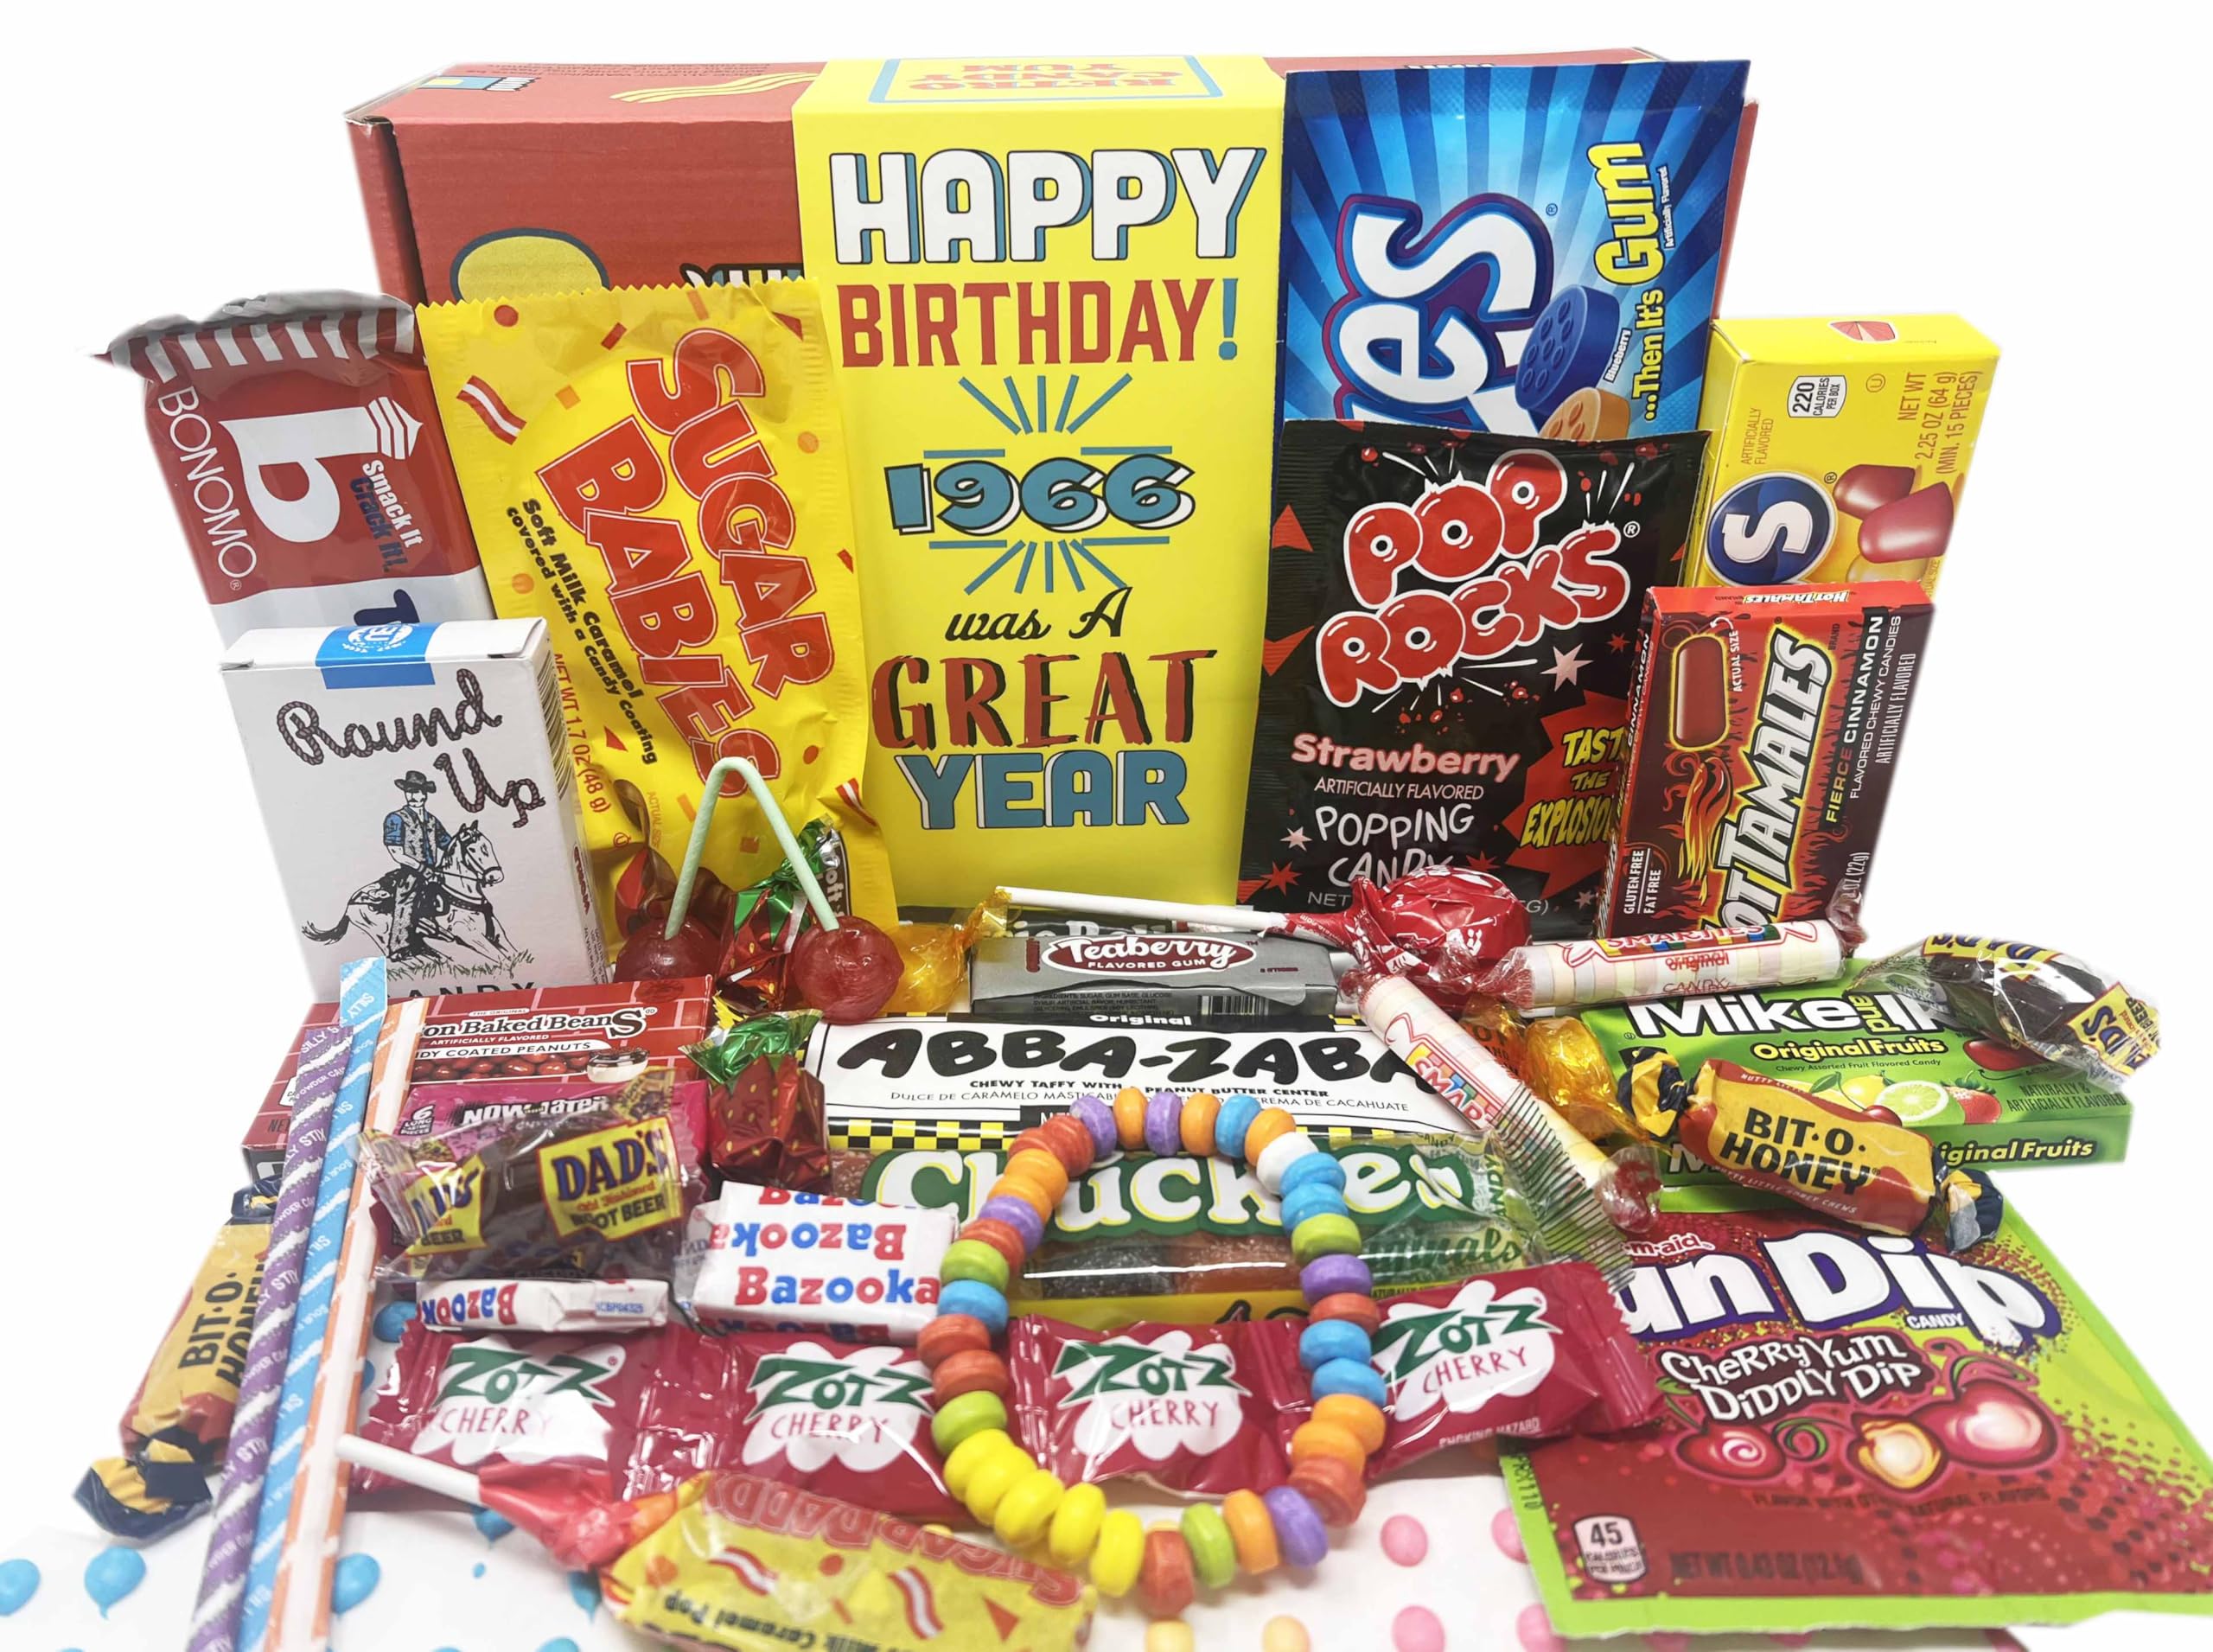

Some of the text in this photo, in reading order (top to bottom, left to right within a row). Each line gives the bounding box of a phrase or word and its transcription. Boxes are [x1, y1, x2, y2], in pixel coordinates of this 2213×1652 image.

[829, 147, 1267, 265] HAPPY
[1587, 141, 1665, 284] Gum
[1657, 166, 1675, 248] Artificially Flavored
[837, 277, 1240, 367] BIRTHDAY!
[1604, 328, 1631, 382] Blueberry
[1793, 382, 1815, 412] 220
[1813, 377, 1830, 417] CALORIES
[1826, 382, 1840, 410] PER BOX
[1897, 372, 1926, 421] NET WT
[1929, 388, 1950, 408] (64
[1949, 371, 1983, 419] PIECES)
[1740, 407, 1774, 465] ARTIFICIALLY FLAVORED
[1923, 412, 1943, 428] OZ
[1946, 422, 1965, 438] 15
[1915, 433, 1938, 460] 2.25
[157, 386, 258, 578] BONOMO
[883, 454, 1196, 536] 1966
[362, 459, 424, 548] Smack It
[626, 328, 834, 699] SUGAR
[1344, 449, 1567, 609] POP
[507, 507, 556, 579] covered
[551, 583, 577, 624] with
[575, 628, 585, 641] a
[522, 498, 644, 699] Soft Milk Caramel
[535, 414, 781, 798] BABIES
[945, 586, 1133, 641] was A
[1317, 520, 1630, 707] ROCKS
[1730, 630, 1744, 692] ACTUAL SIZE
[277, 668, 503, 765] Round
[562, 689, 579, 711] WT
[871, 650, 1218, 750] GREAT
[1826, 616, 1884, 823] FIERCE CINNAMON
[1850, 616, 1901, 800] FLAVORED CHEWY CANDIES
[1875, 653, 1916, 764] ARTIFICIALLY FLAVORED
[566, 718, 587, 740] 1.7
[1291, 733, 1521, 783] Strawberry
[1714, 627, 1834, 888] TAMALES
[433, 748, 546, 828] Up
[577, 769, 603, 794] (48
[894, 749, 1189, 830] YEAR
[1314, 776, 1484, 800] ARTIFICIALLY FLAVORED
[1571, 771, 1611, 790] THE
[1315, 803, 1475, 850] POPPING
[1308, 890, 1352, 907] NET
[1623, 850, 1644, 915] GLUTEN FREE
[1643, 870, 1661, 914] FAT FREE
[1063, 936, 1238, 969] Teaberry
[1087, 958, 1206, 969] FLAVORED GUM
[462, 1015, 545, 1036] Baked
[1090, 1014, 1192, 1026] Original
[1629, 992, 1861, 1037] Mike
[300, 1031, 328, 1054] SILLY
[430, 1033, 549, 1045] ARTIFICIALLY FLAVORED
[446, 1042, 591, 1057] COATED PEANUTS
[1753, 1036, 1948, 1063] Original Fruits
[1776, 1064, 1805, 1073] Chewy
[1808, 1062, 1846, 1071] Assorted
[1871, 1060, 1910, 1068] Flavored
[1911, 1058, 1942, 1068] Candy
[890, 1091, 1409, 1113] DULCE DE CARAMELO DE CACAHUATE
[969, 1080, 1024, 1088] CHEWY
[1032, 1081, 1075, 1089] TAFFY
[1082, 1081, 1122, 1090] WITH
[1211, 1087, 1267, 1095] BUTTER
[1272, 1088, 1330, 1098] CENTER
[2006, 1094, 2126, 1113] ARTIFICIALLY FLAVORED
[2021, 1081, 2079, 1097] NATURALLY
[404, 1117, 432, 1127] LONG
[413, 1106, 434, 1120] 6
[1719, 1132, 1872, 1195] HONEY
[2022, 1139, 2094, 1161] Fruits
[622, 1194, 667, 1222] BEER
[1822, 1199, 1858, 1215] CHEWS
[709, 1221, 907, 1260] Bazooka
[735, 1266, 941, 1305] Bazooka
[1762, 1232, 2057, 1349] Dip
[1906, 1313, 1965, 1329] CANDY
[1422, 1346, 1527, 1394] CHERRY
[438, 1406, 554, 1435] CHERRY
[770, 1413, 890, 1445] CHERRY
[1111, 1399, 1219, 1429] CHERRY
[1591, 1521, 1623, 1547] 45
[664, 1589, 815, 1649] Caramel Pop
